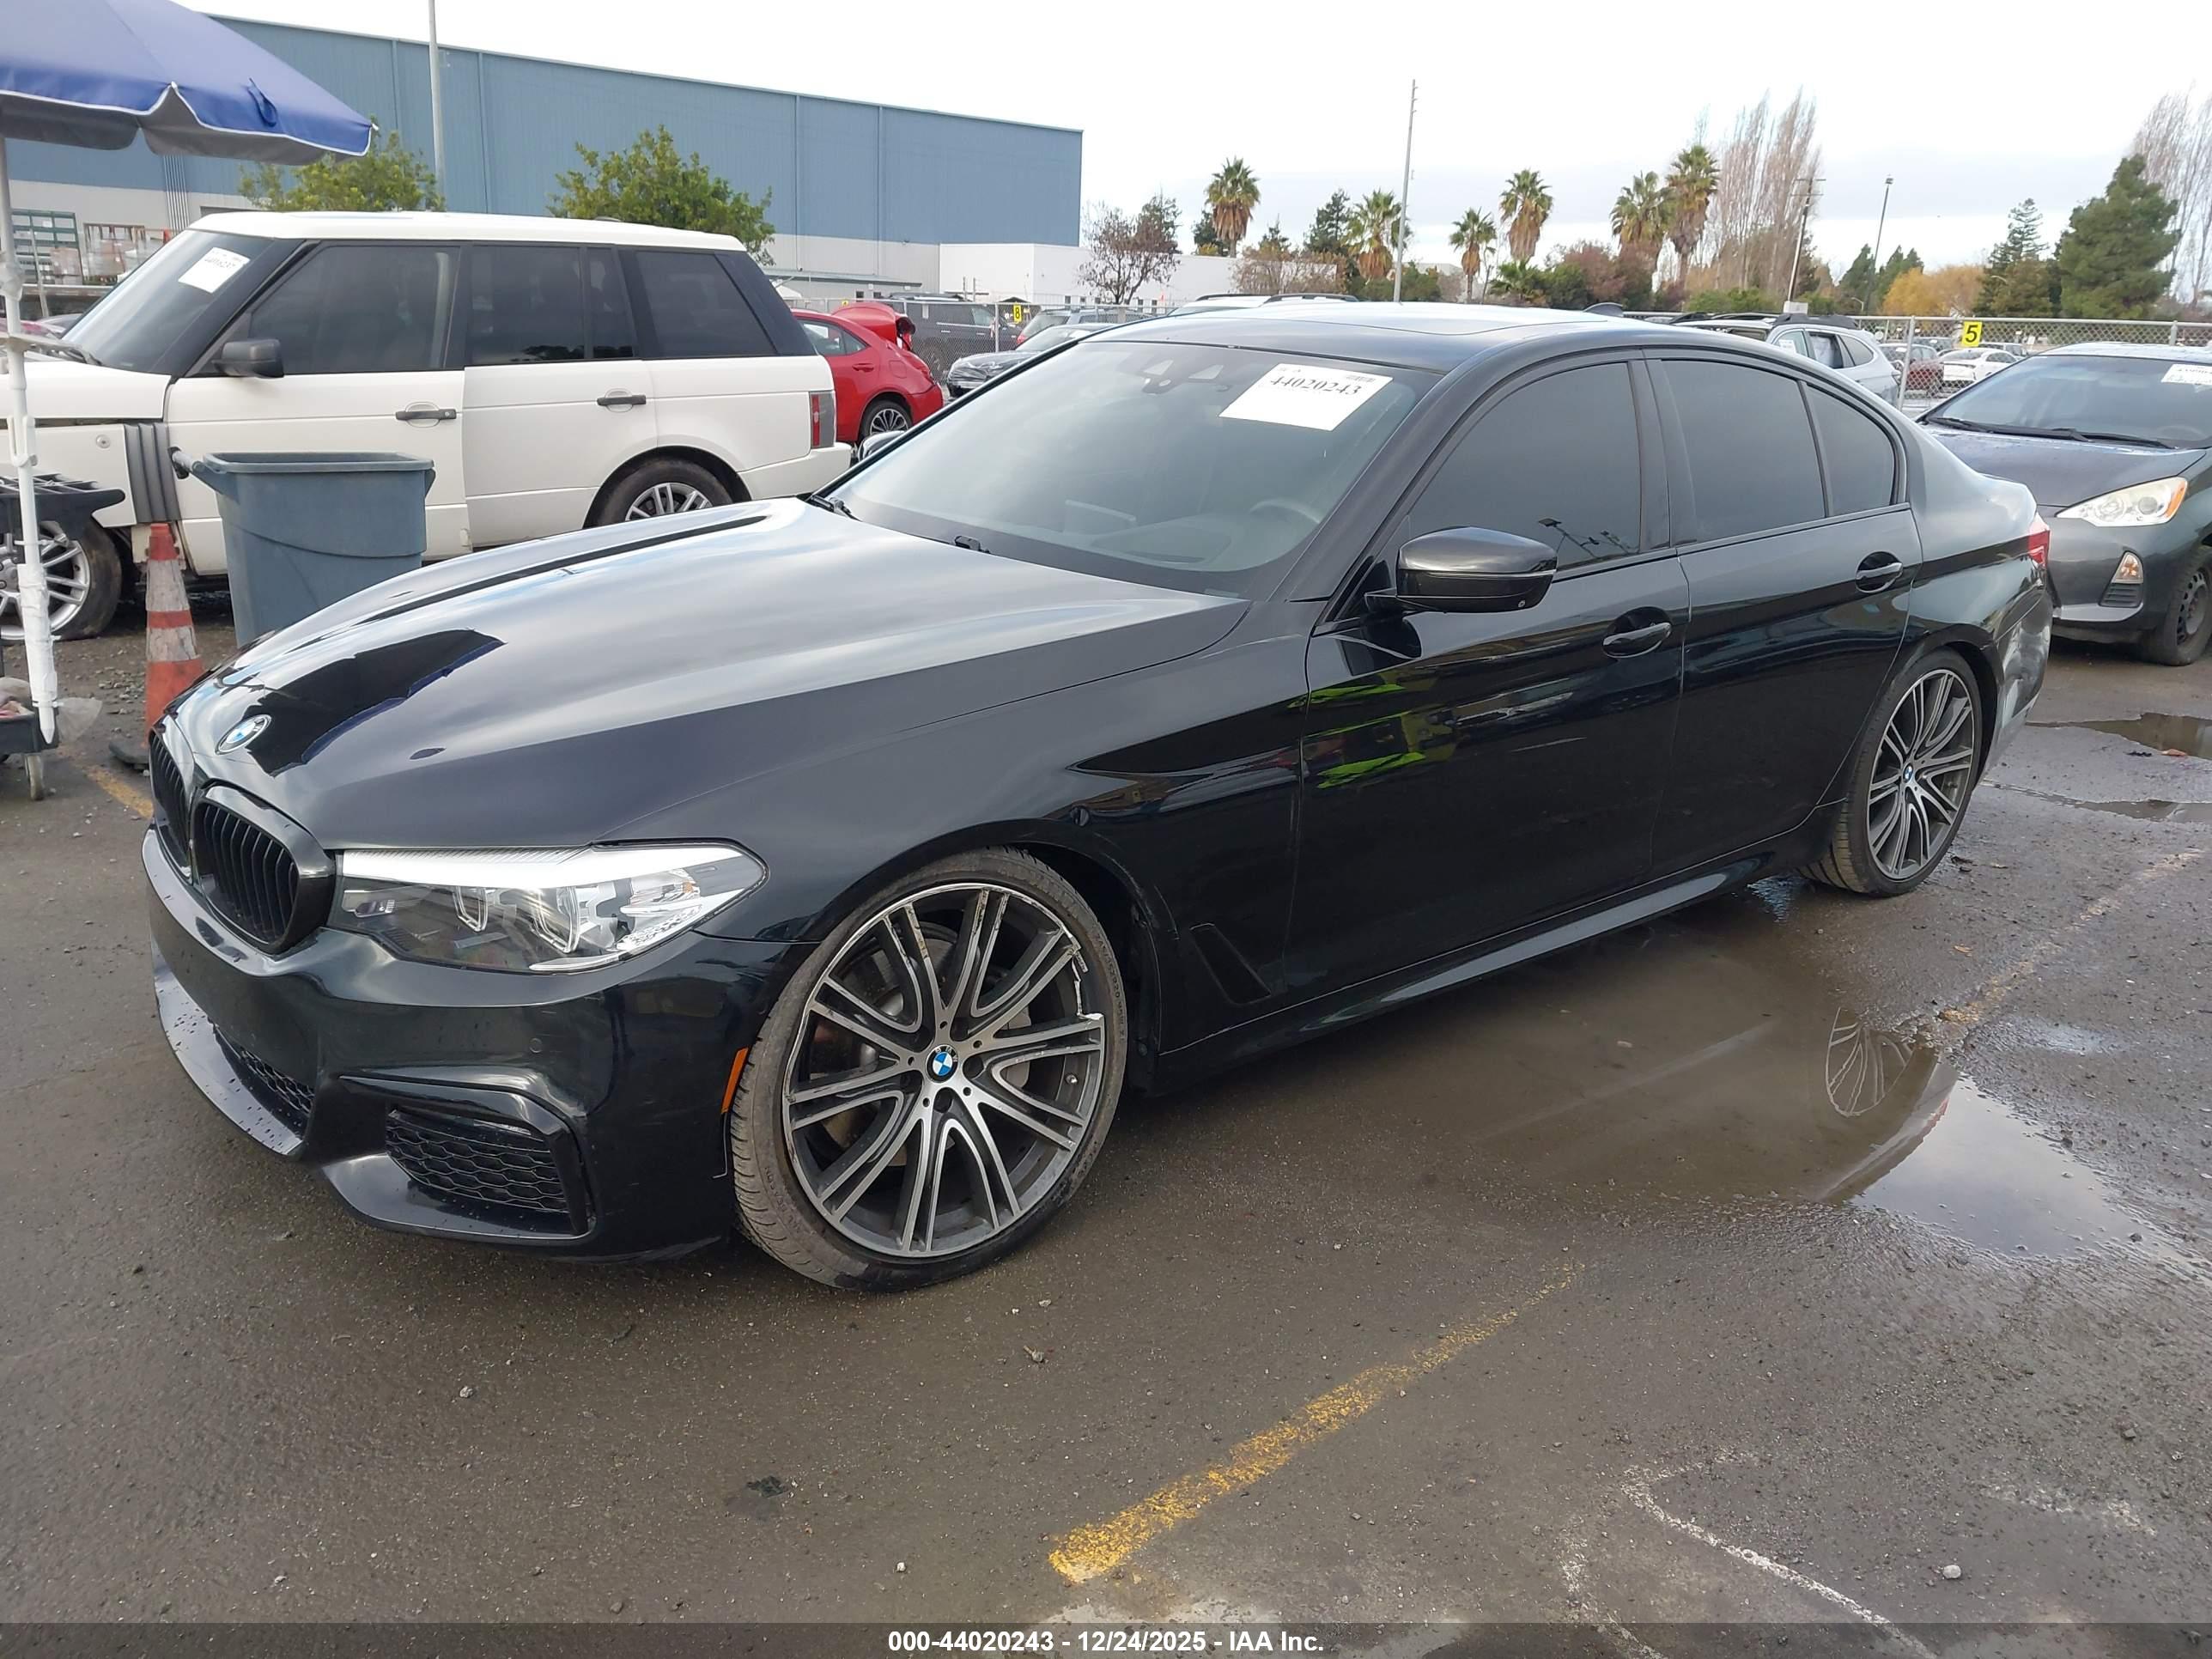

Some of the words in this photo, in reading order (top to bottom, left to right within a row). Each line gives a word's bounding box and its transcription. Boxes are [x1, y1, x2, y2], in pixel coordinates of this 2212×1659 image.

[1015, 307, 1021, 319] 8
[1966, 325, 1978, 343] 5
[1270, 375, 1362, 395] 44020243
